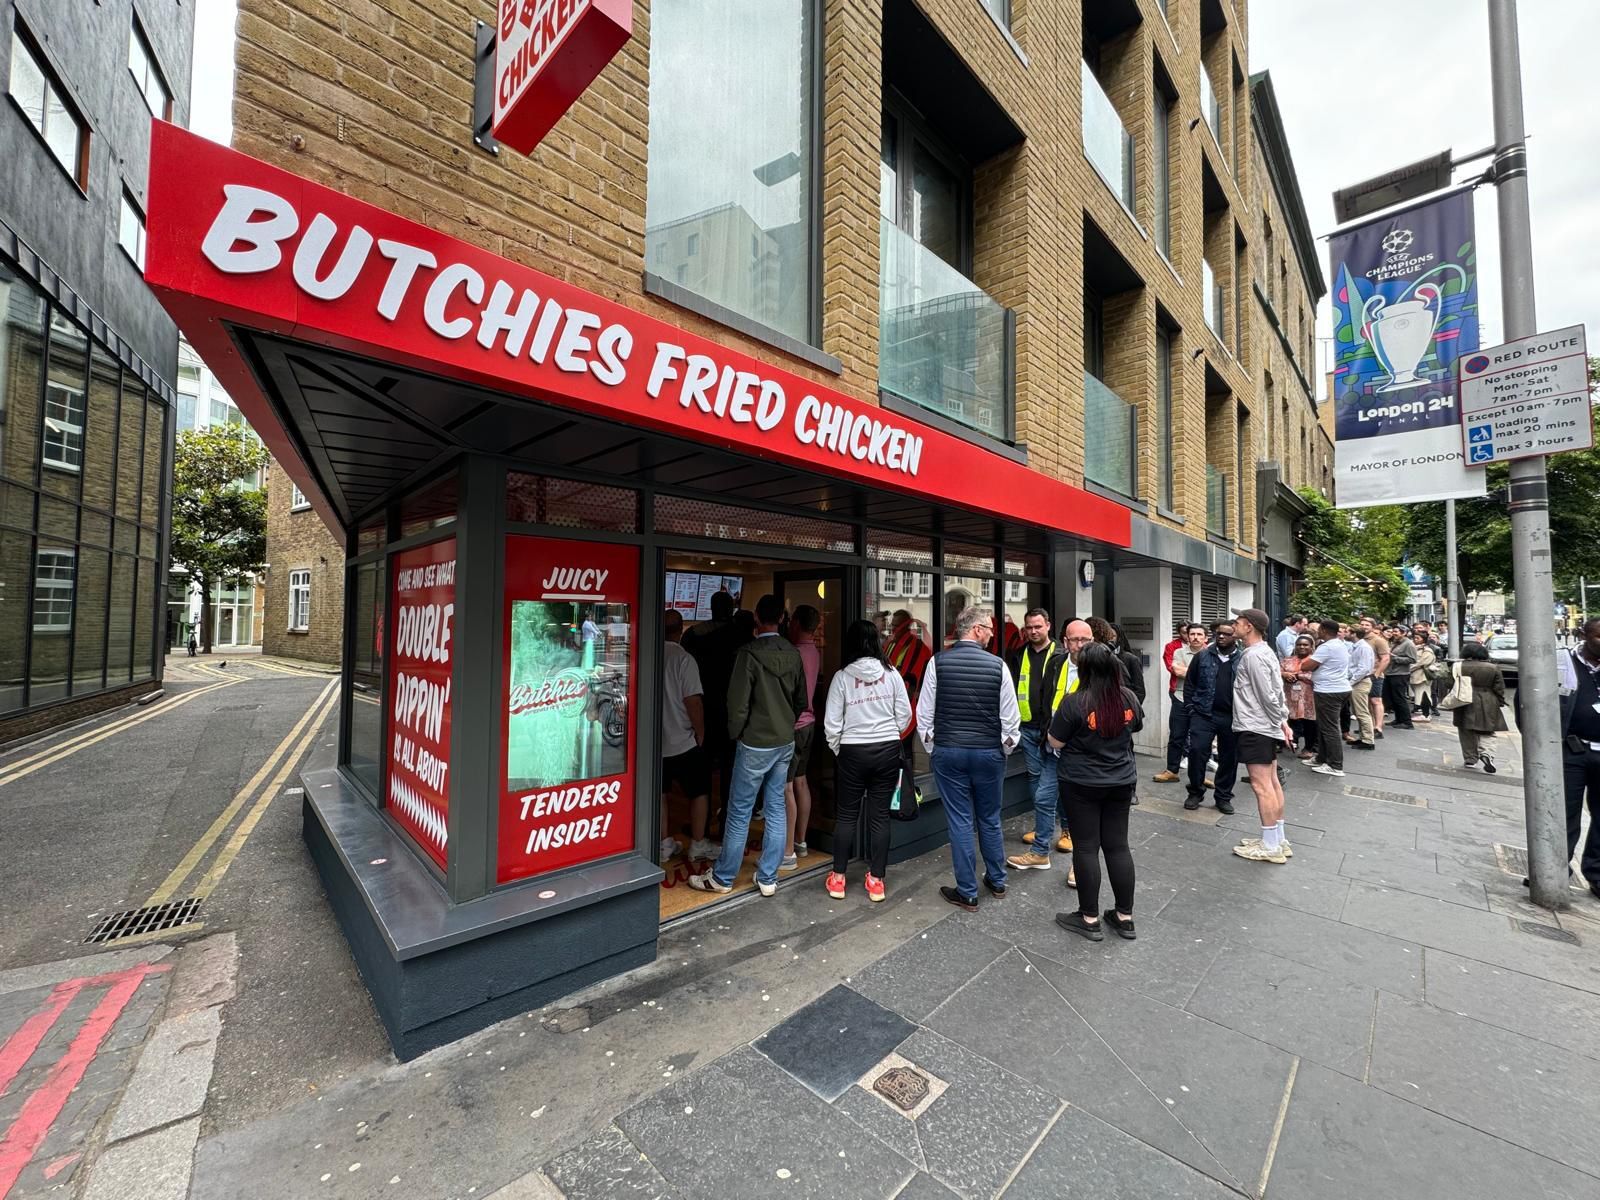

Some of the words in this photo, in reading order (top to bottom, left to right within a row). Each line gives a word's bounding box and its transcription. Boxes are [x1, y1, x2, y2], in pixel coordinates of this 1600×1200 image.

[1365, 253, 1434, 278] CHAMPIONS
[1377, 264, 1423, 280] LEAGUE
[201, 184, 633, 386] BUTCHIES
[646, 341, 786, 431] FRIED
[794, 395, 922, 476] CHICKEN
[1494, 350, 1522, 364] RED
[1527, 337, 1578, 355] ROUTE
[1485, 376, 1501, 385] No
[1505, 364, 1558, 381] stopping
[1428, 395, 1454, 411] 24
[1467, 409, 1507, 423] Except
[1495, 416, 1539, 430] loading
[1495, 429, 1520, 439] max
[1523, 424, 1541, 433] 20
[1545, 420, 1576, 430] mins
[1496, 444, 1521, 454] max
[1524, 440, 1533, 448] 3
[1537, 436, 1574, 446] hours
[1350, 461, 1390, 472] MAYOR
[1392, 458, 1408, 467] OF
[398, 569, 412, 592] COME
[411, 567, 424, 589] AND
[424, 564, 436, 588] SEE
[436, 559, 456, 587] WHAT
[542, 566, 609, 592] JUICY
[397, 603, 454, 664] DOUBLE
[395, 671, 451, 745] DIPPIN'
[394, 731, 402, 762] IS
[401, 737, 415, 773] ALL
[416, 746, 448, 796] ABOUT
[520, 780, 621, 821] TENDERS
[525, 812, 613, 854] INSIDE!
